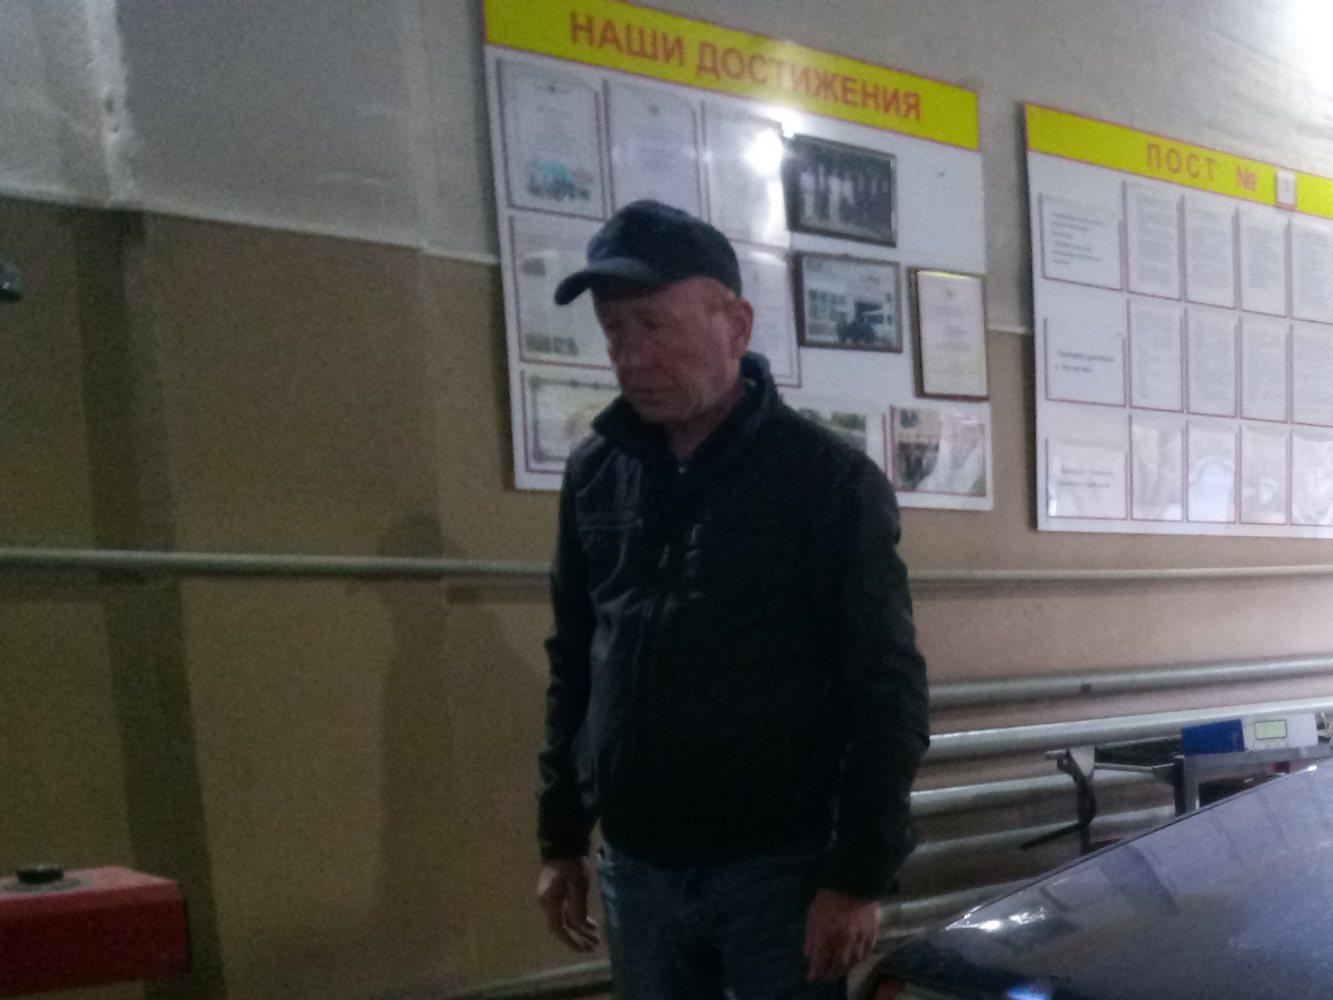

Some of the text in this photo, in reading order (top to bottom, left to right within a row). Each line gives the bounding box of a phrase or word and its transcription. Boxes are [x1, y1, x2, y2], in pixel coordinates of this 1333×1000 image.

[569, 11, 922, 120] НАШИ ДОСТИЖЕНИЯ
[1146, 143, 1216, 181] ПОСТ
